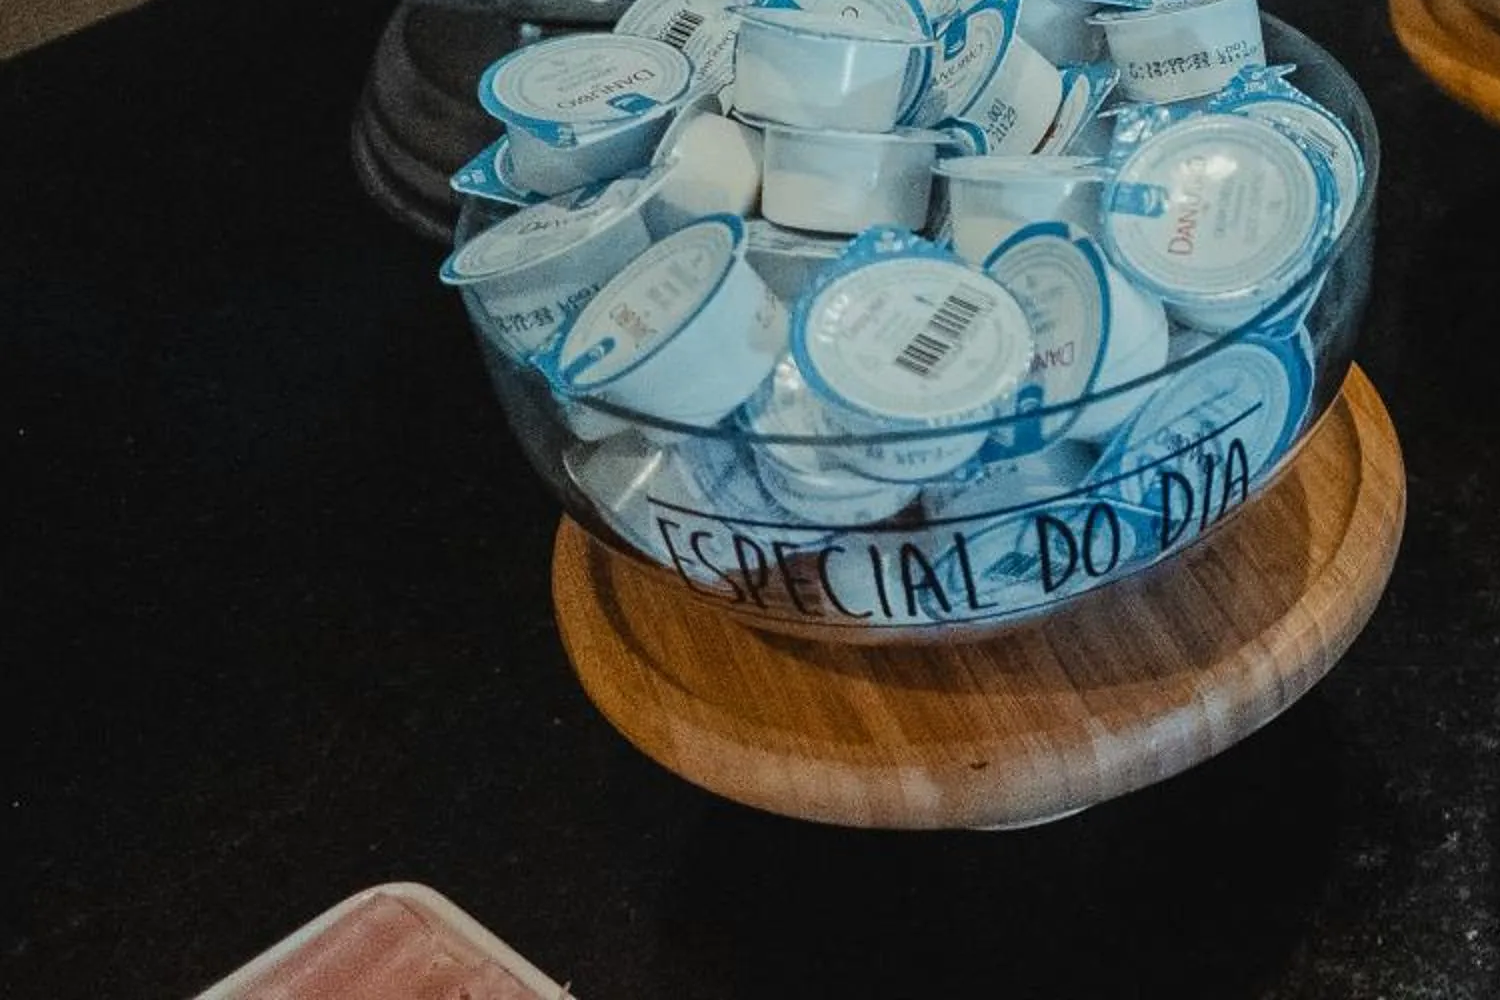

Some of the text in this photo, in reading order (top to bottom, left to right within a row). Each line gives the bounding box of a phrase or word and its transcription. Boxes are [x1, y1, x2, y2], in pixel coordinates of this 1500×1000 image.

[656, 515, 997, 621] ESPECIAL
[1035, 502, 1120, 594] DO
[1160, 438, 1250, 552] DIA
